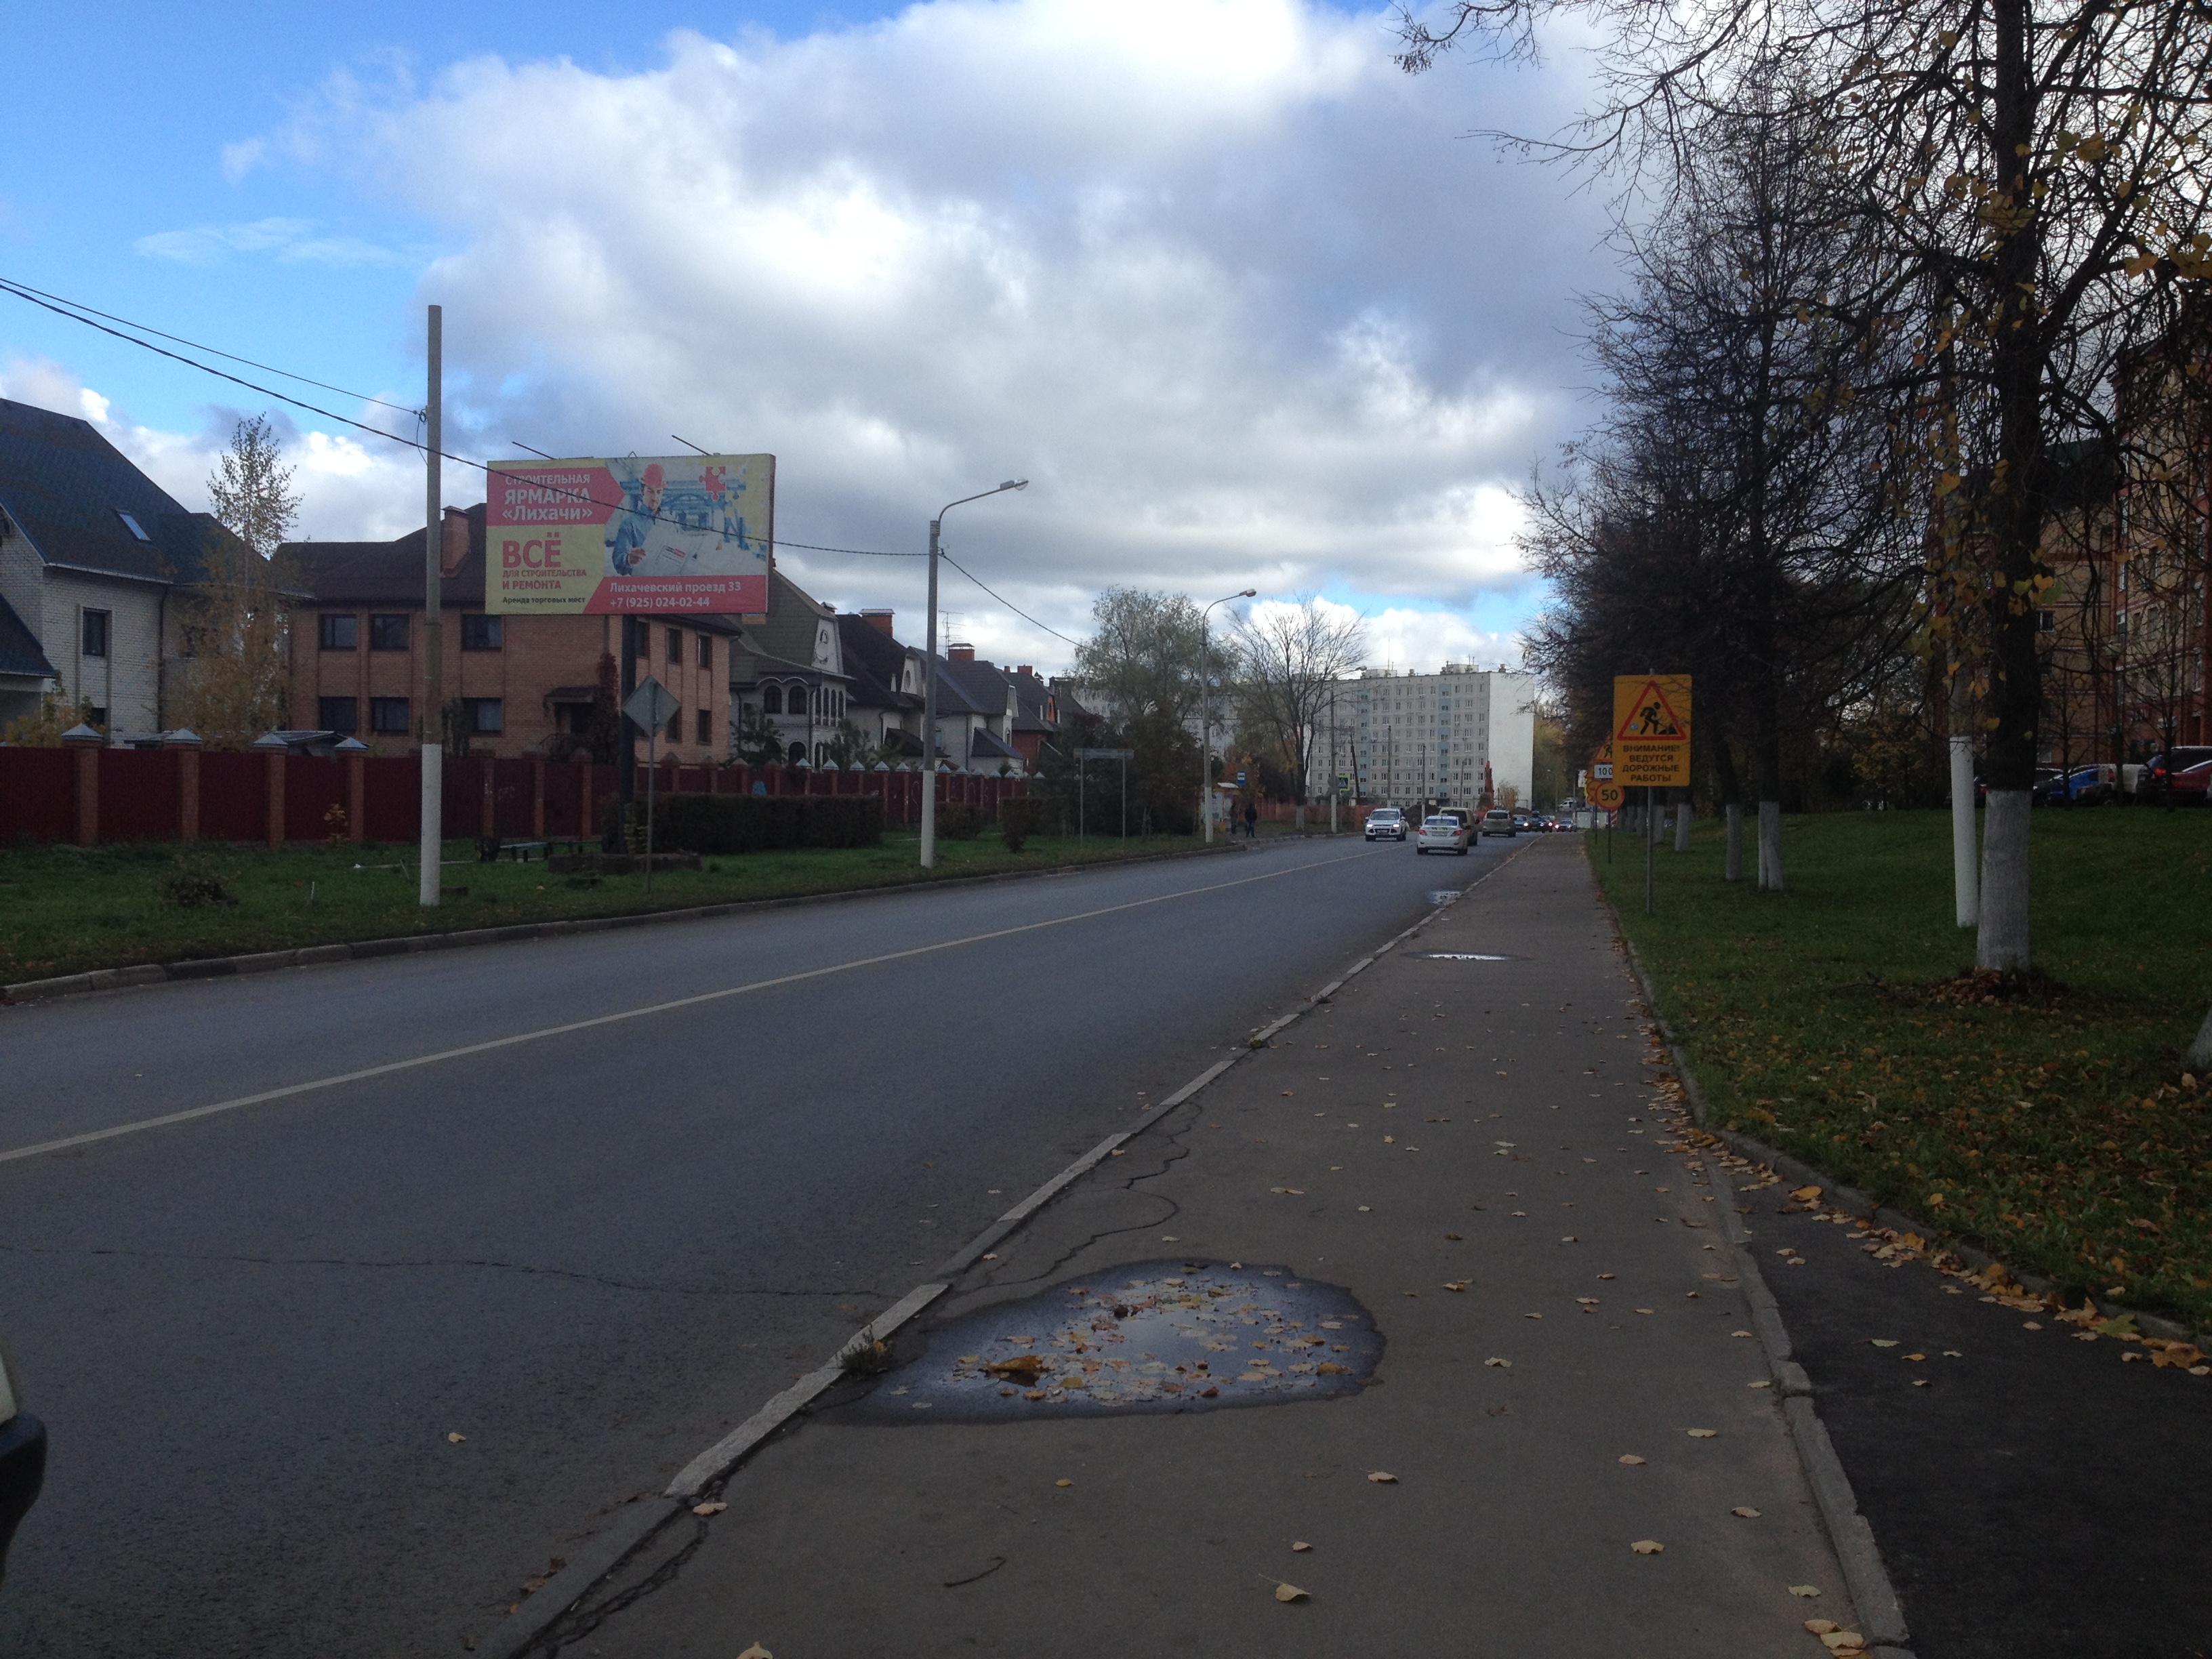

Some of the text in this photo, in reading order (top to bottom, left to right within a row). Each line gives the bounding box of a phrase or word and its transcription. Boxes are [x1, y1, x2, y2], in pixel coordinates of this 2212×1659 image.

[505, 474, 590, 485] СТРОИТЕЛЬНАЯ
[504, 488, 592, 504] ЯРМАРКА
[501, 506, 593, 520] «Лихачи»
[502, 531, 562, 568] ВСЁ
[502, 569, 587, 578] ДЛЯ СТРОИТЕЛЬСТВА
[502, 580, 562, 590] И РЕМОНТА
[609, 581, 742, 594] Лихачевский проезд 33
[610, 597, 710, 609] +7 (925) 024-02-44
[1629, 754, 1673, 763] ВЕДУТСЯ
[1622, 764, 1679, 773] ДОРОЖНЫЕ
[1601, 789, 1618, 800] 50
